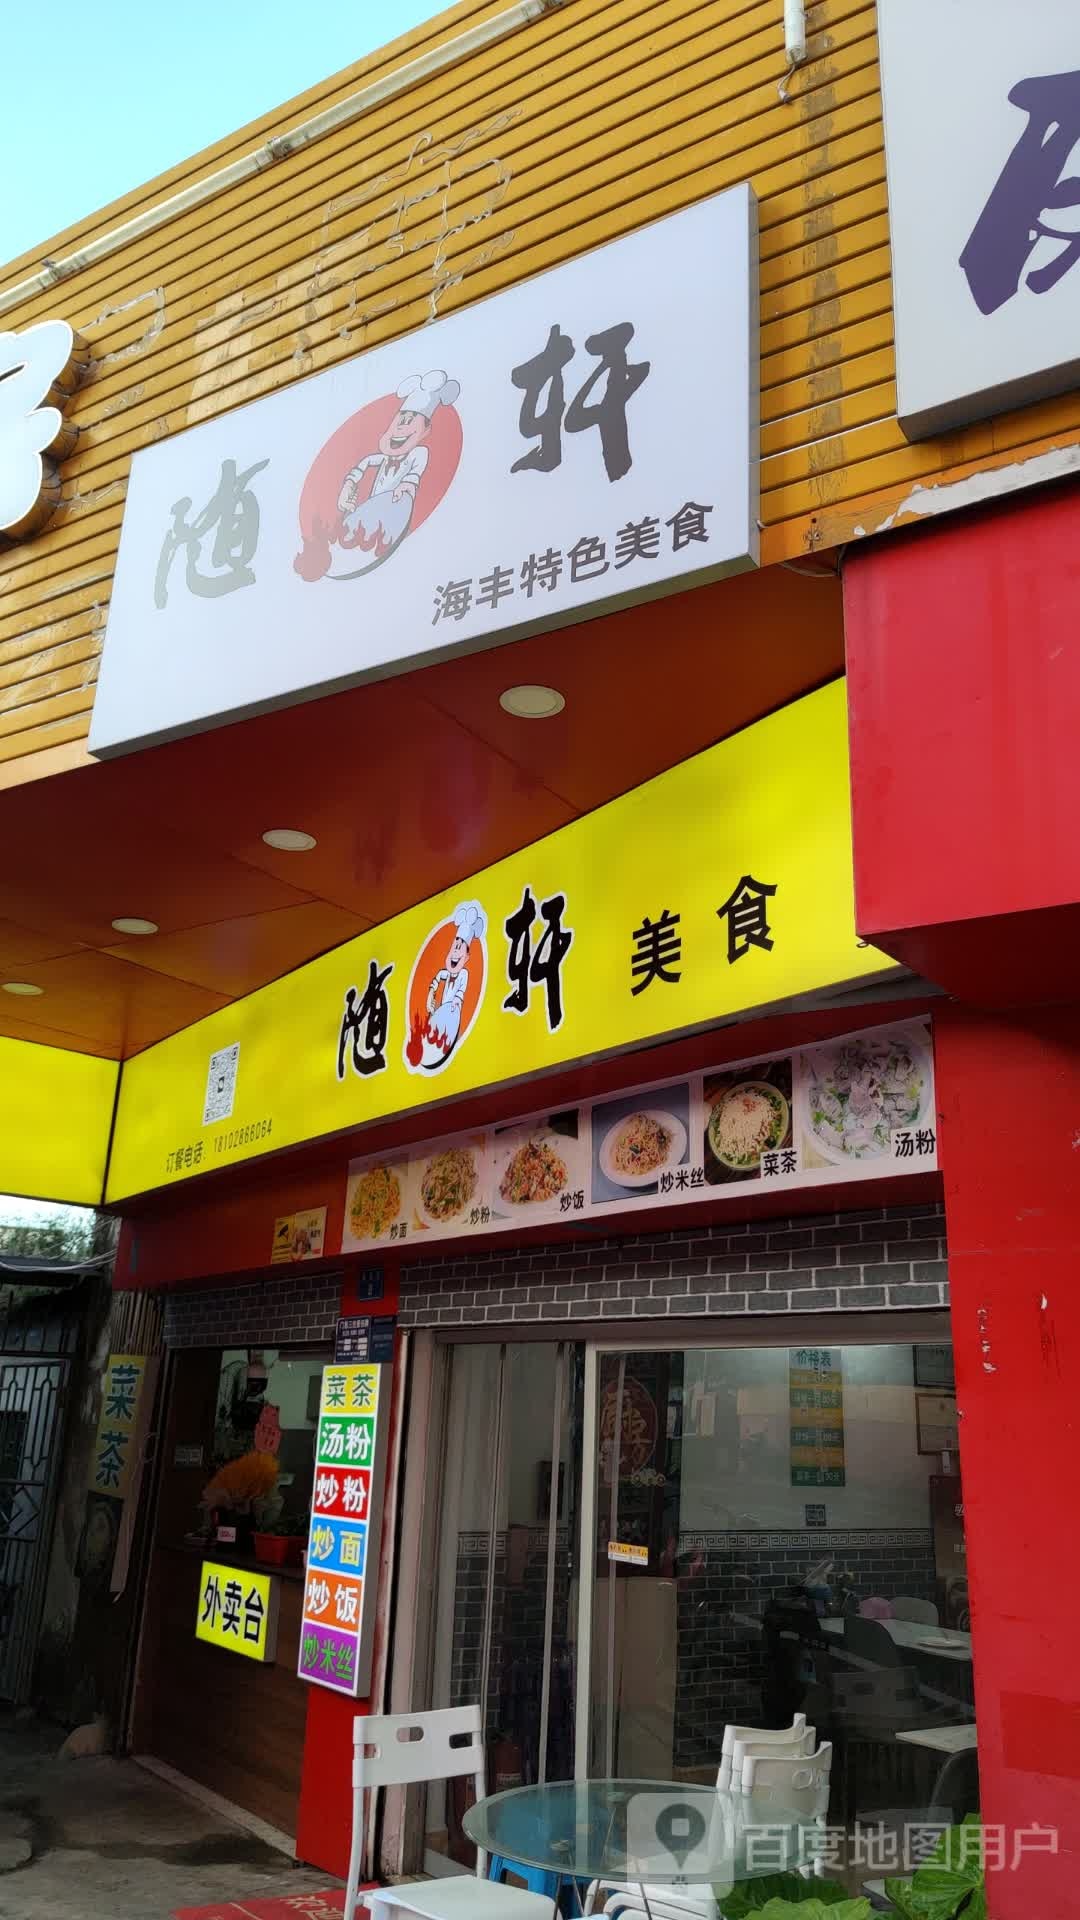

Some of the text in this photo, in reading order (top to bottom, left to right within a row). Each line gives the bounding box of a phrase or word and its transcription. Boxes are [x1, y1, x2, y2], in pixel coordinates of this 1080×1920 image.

[154, 322, 651, 610] 随 轩
[431, 501, 714, 626] 海丰特色美食
[337, 874, 778, 1079] 随 轩 美食
[895, 1128, 936, 1158] 汤粉
[660, 1167, 705, 1193] 炒米丝
[763, 1151, 798, 1177] 菜茶
[470, 1206, 491, 1225] 炒粉
[560, 1190, 584, 1212] 炒饭
[390, 1222, 408, 1240] 炒面
[326, 1373, 374, 1407] 菜茶
[96, 1364, 140, 1488] 菜茶
[320, 1422, 371, 1460] 汤粉
[316, 1473, 366, 1513] 炒粉
[311, 1525, 363, 1567] 炒面
[202, 1575, 264, 1644] 外卖台
[307, 1578, 358, 1624] 炒饭
[303, 1633, 353, 1681] 炒米丝
